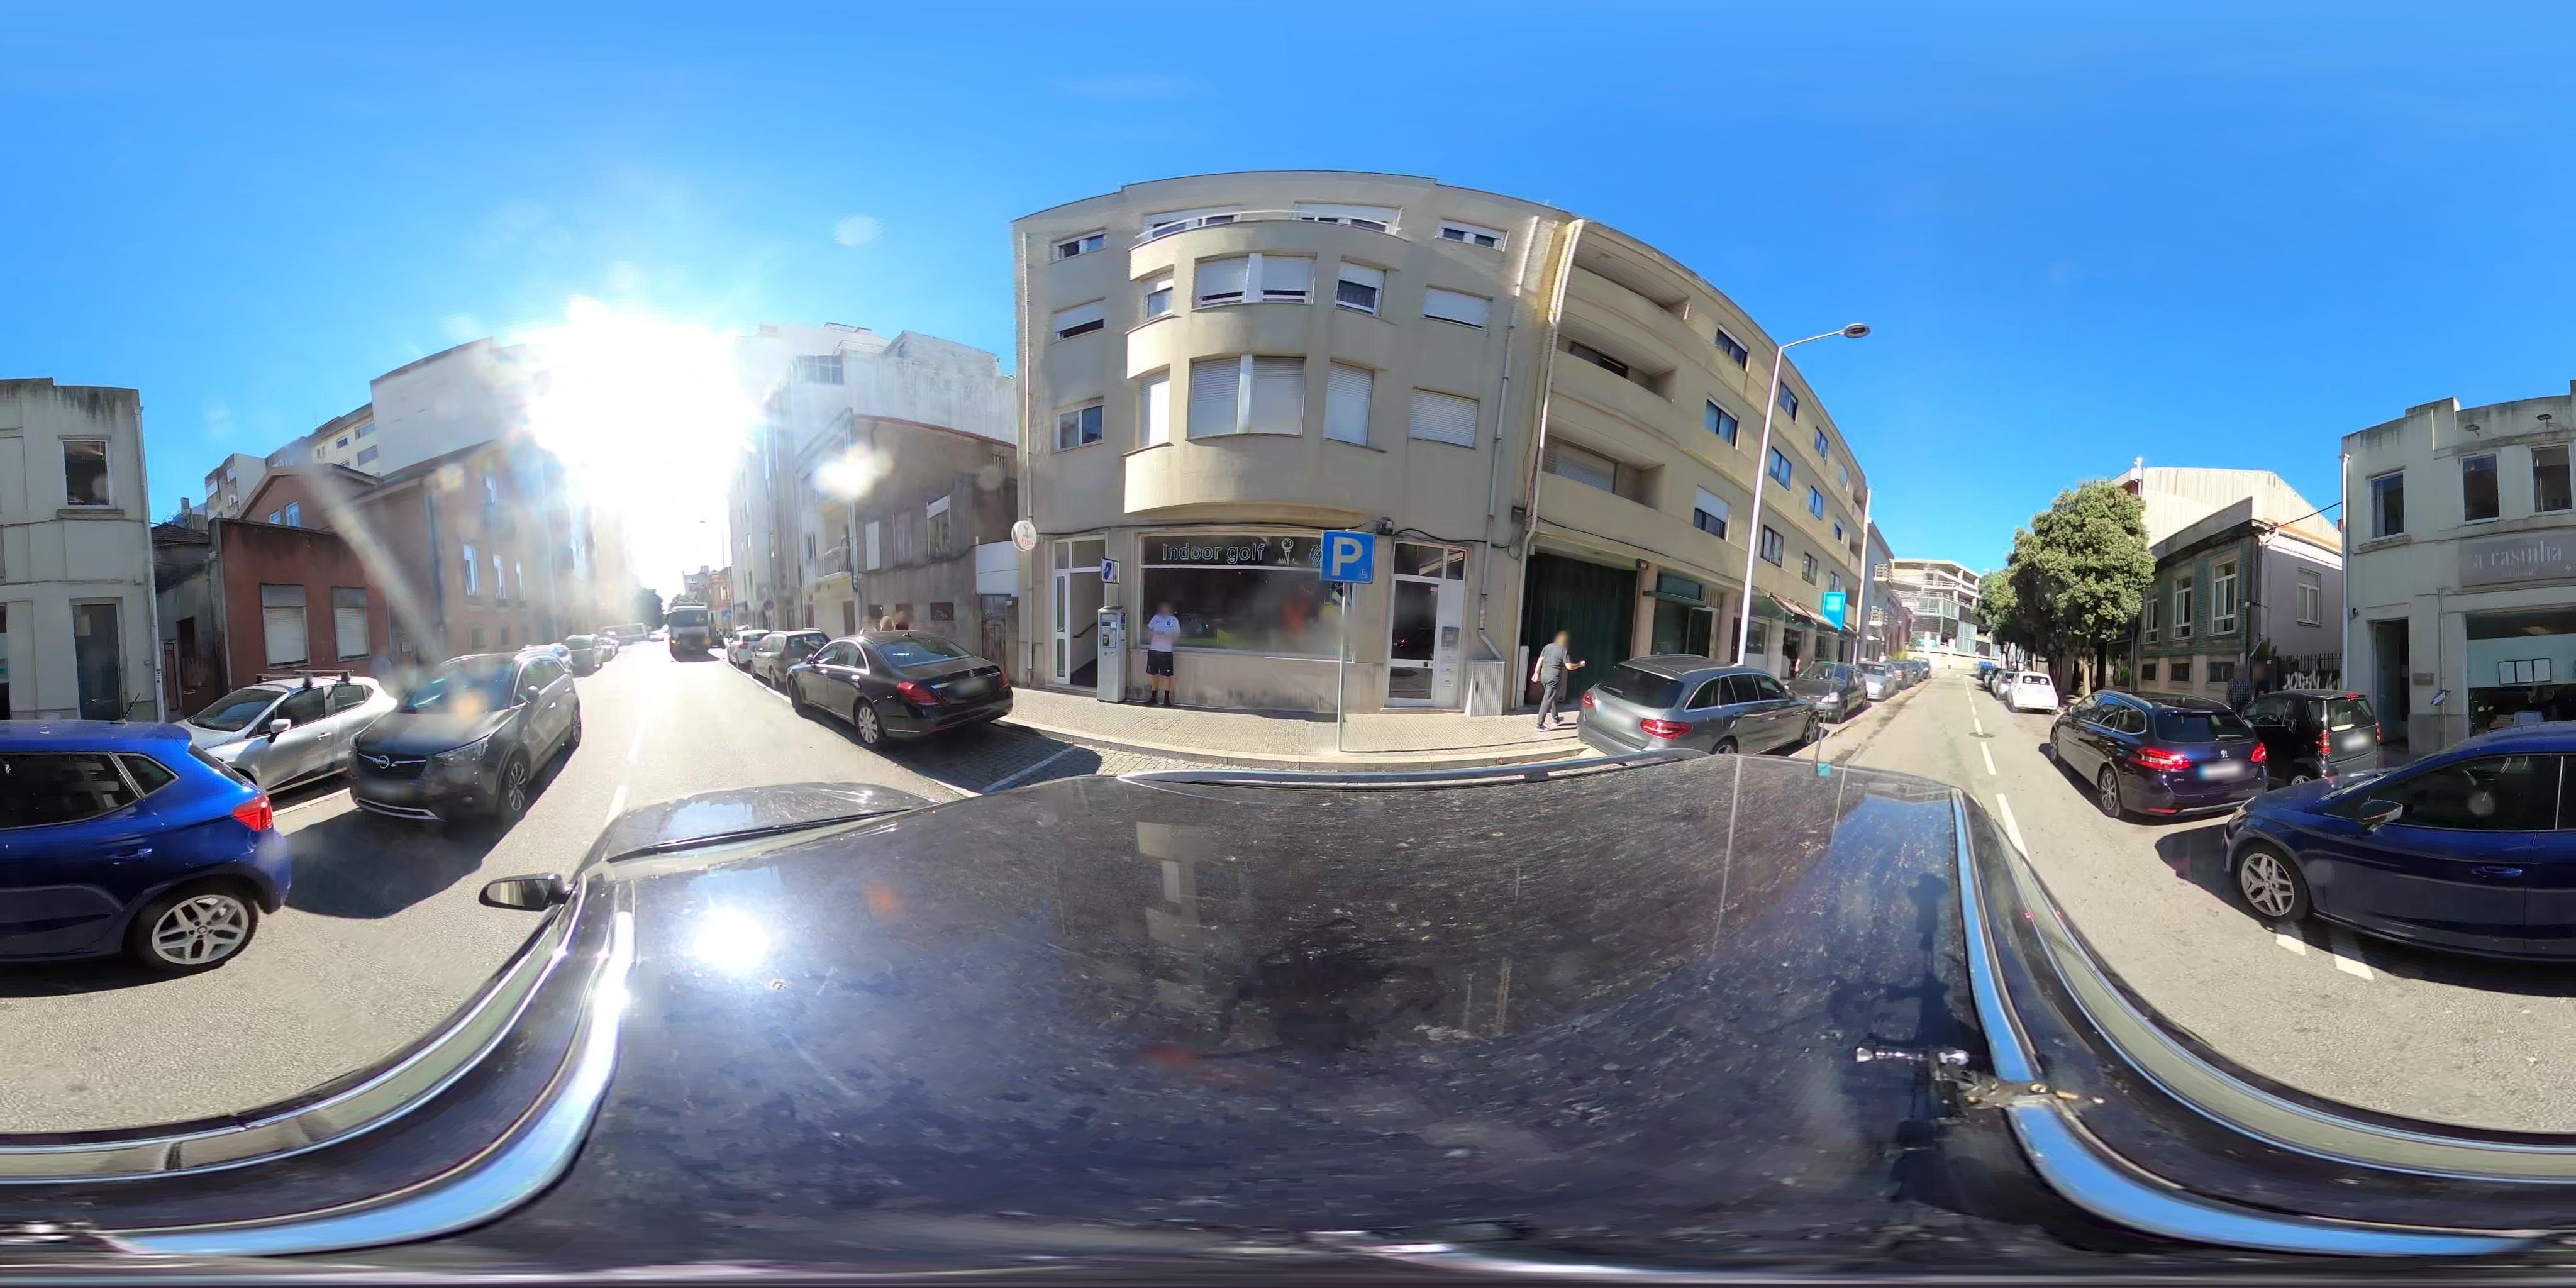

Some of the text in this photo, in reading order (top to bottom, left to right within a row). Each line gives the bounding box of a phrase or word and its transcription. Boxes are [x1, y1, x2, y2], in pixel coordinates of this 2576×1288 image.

[1162, 543, 1265, 565] indoor golf
[1331, 536, 1363, 577] P
